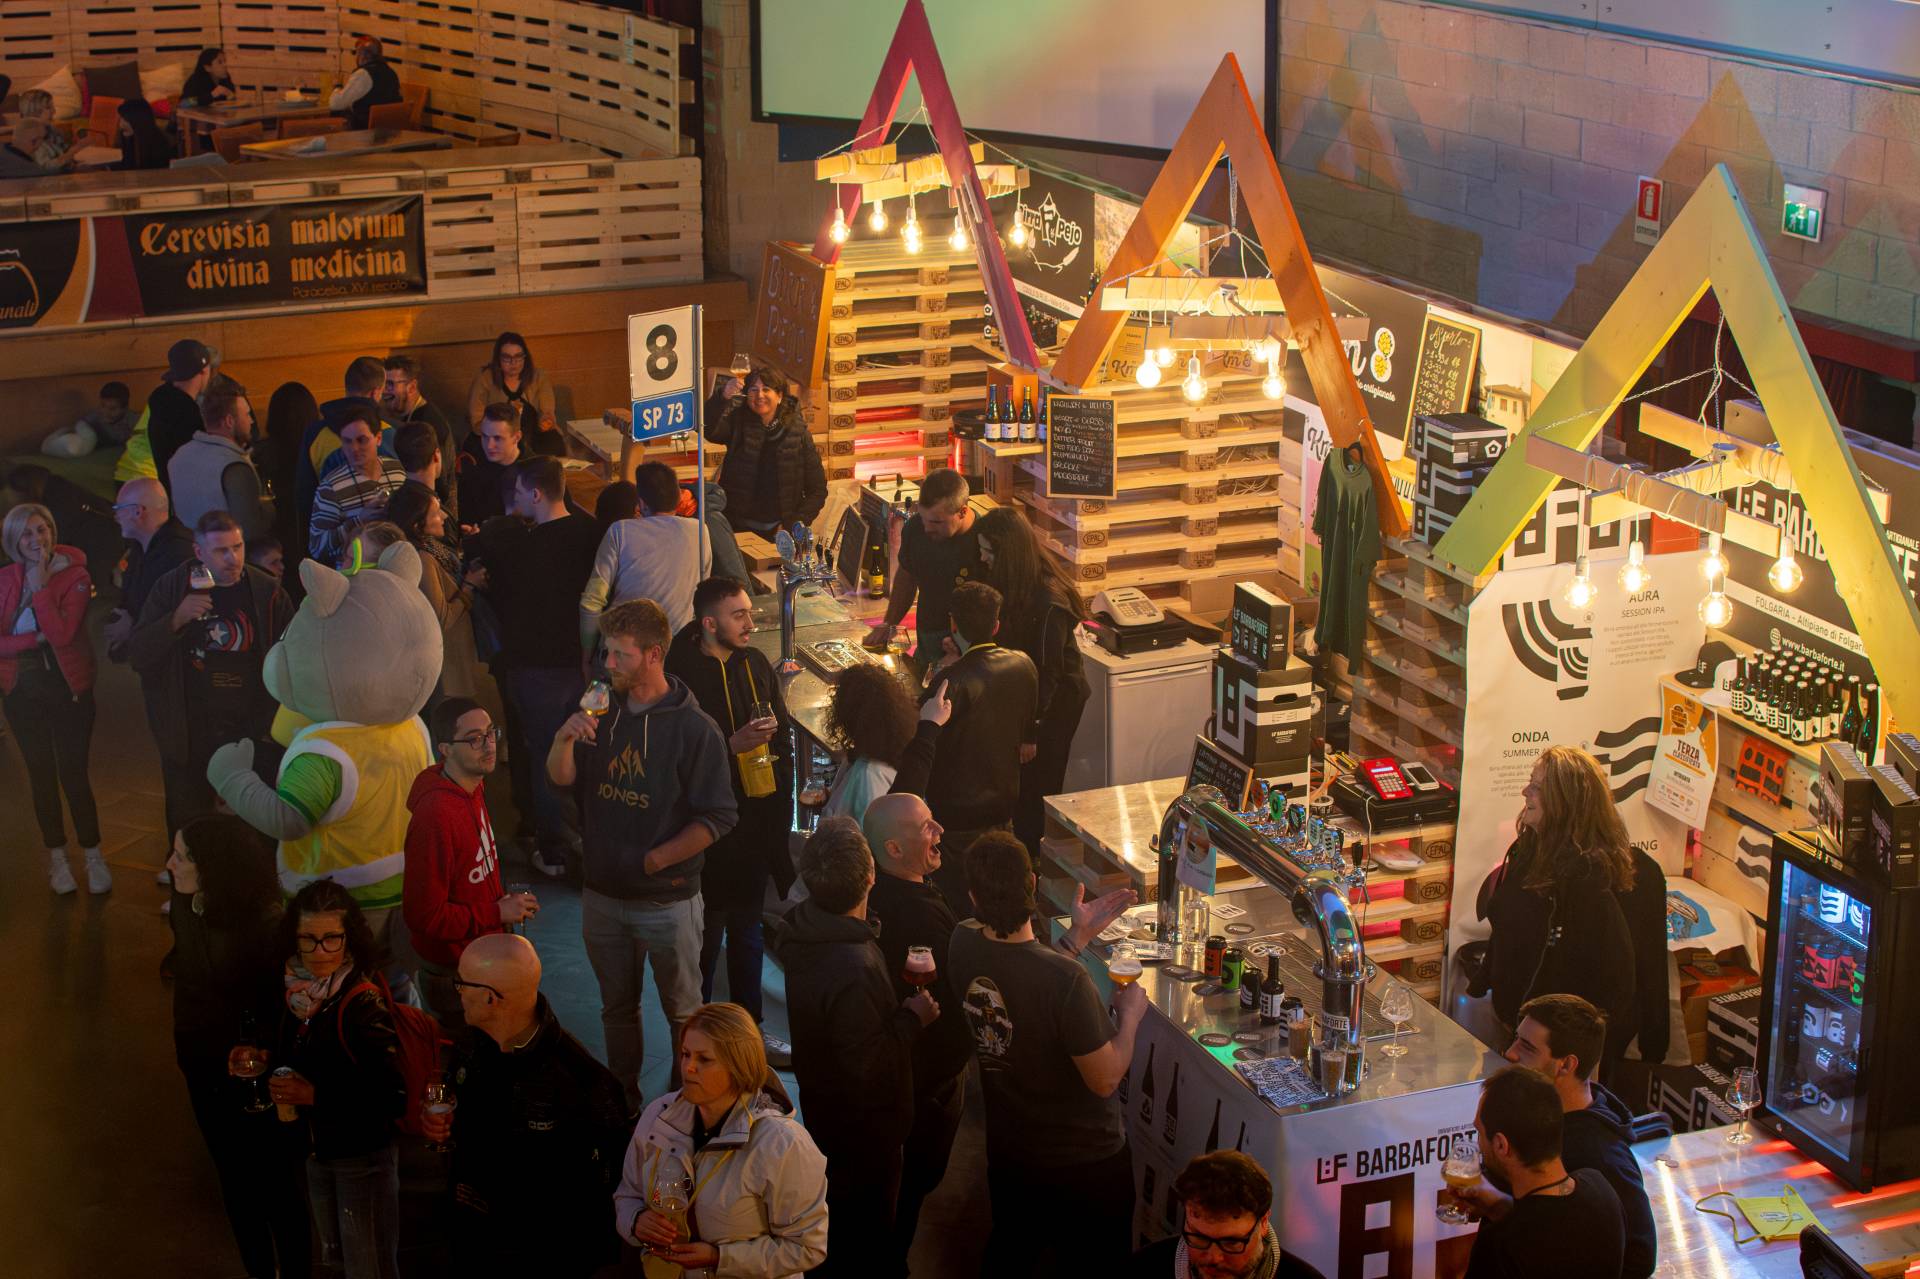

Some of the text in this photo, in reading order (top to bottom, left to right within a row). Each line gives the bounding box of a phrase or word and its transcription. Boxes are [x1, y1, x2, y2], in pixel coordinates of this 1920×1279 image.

[140, 210, 405, 256] Cerevisia malorum
[186, 248, 406, 289] divina medicina
[646, 324, 679, 382] 8
[642, 402, 685, 431] SP 73
[1629, 589, 1660, 603] AURA
[1621, 606, 1665, 618] SESSION IPA
[1755, 595, 1791, 620] FOLGARIA
[1797, 615, 1829, 637] Altipiano
[1830, 628, 1838, 640] di
[1782, 636, 1846, 673] www.barbaforte.it
[1511, 730, 1550, 744] ONDA
[1677, 739, 1700, 761] TERZA
[1503, 749, 1540, 758] SUMMER
